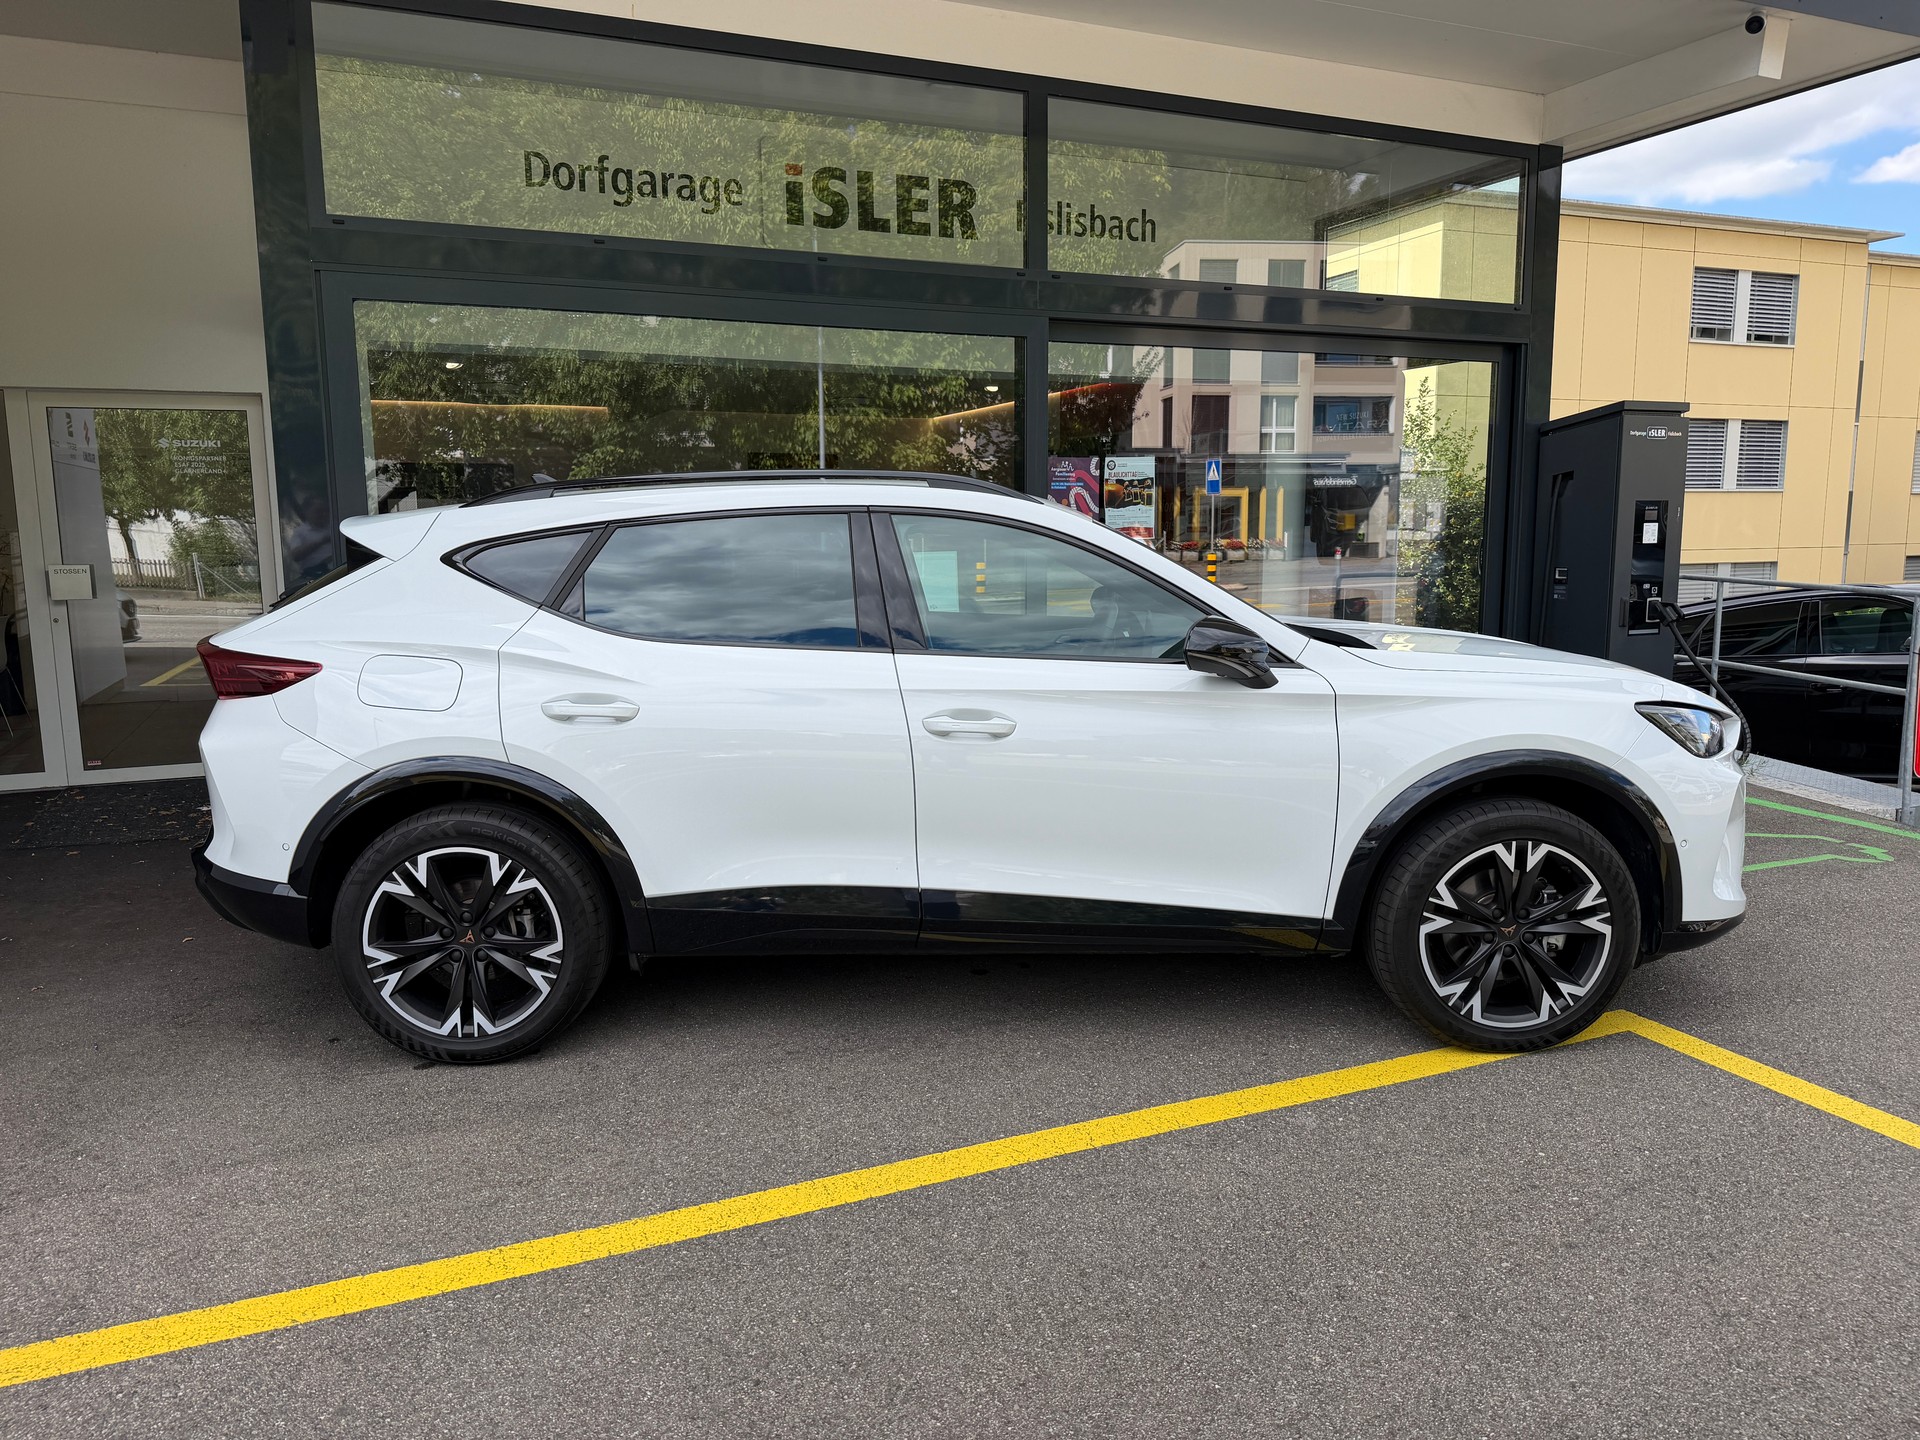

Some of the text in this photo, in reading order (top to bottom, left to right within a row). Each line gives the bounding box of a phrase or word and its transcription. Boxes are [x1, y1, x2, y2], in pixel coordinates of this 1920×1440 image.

[524, 149, 743, 215] Dorfgarage
[784, 163, 979, 240] iSLER
[172, 439, 221, 448] SUZUKI
